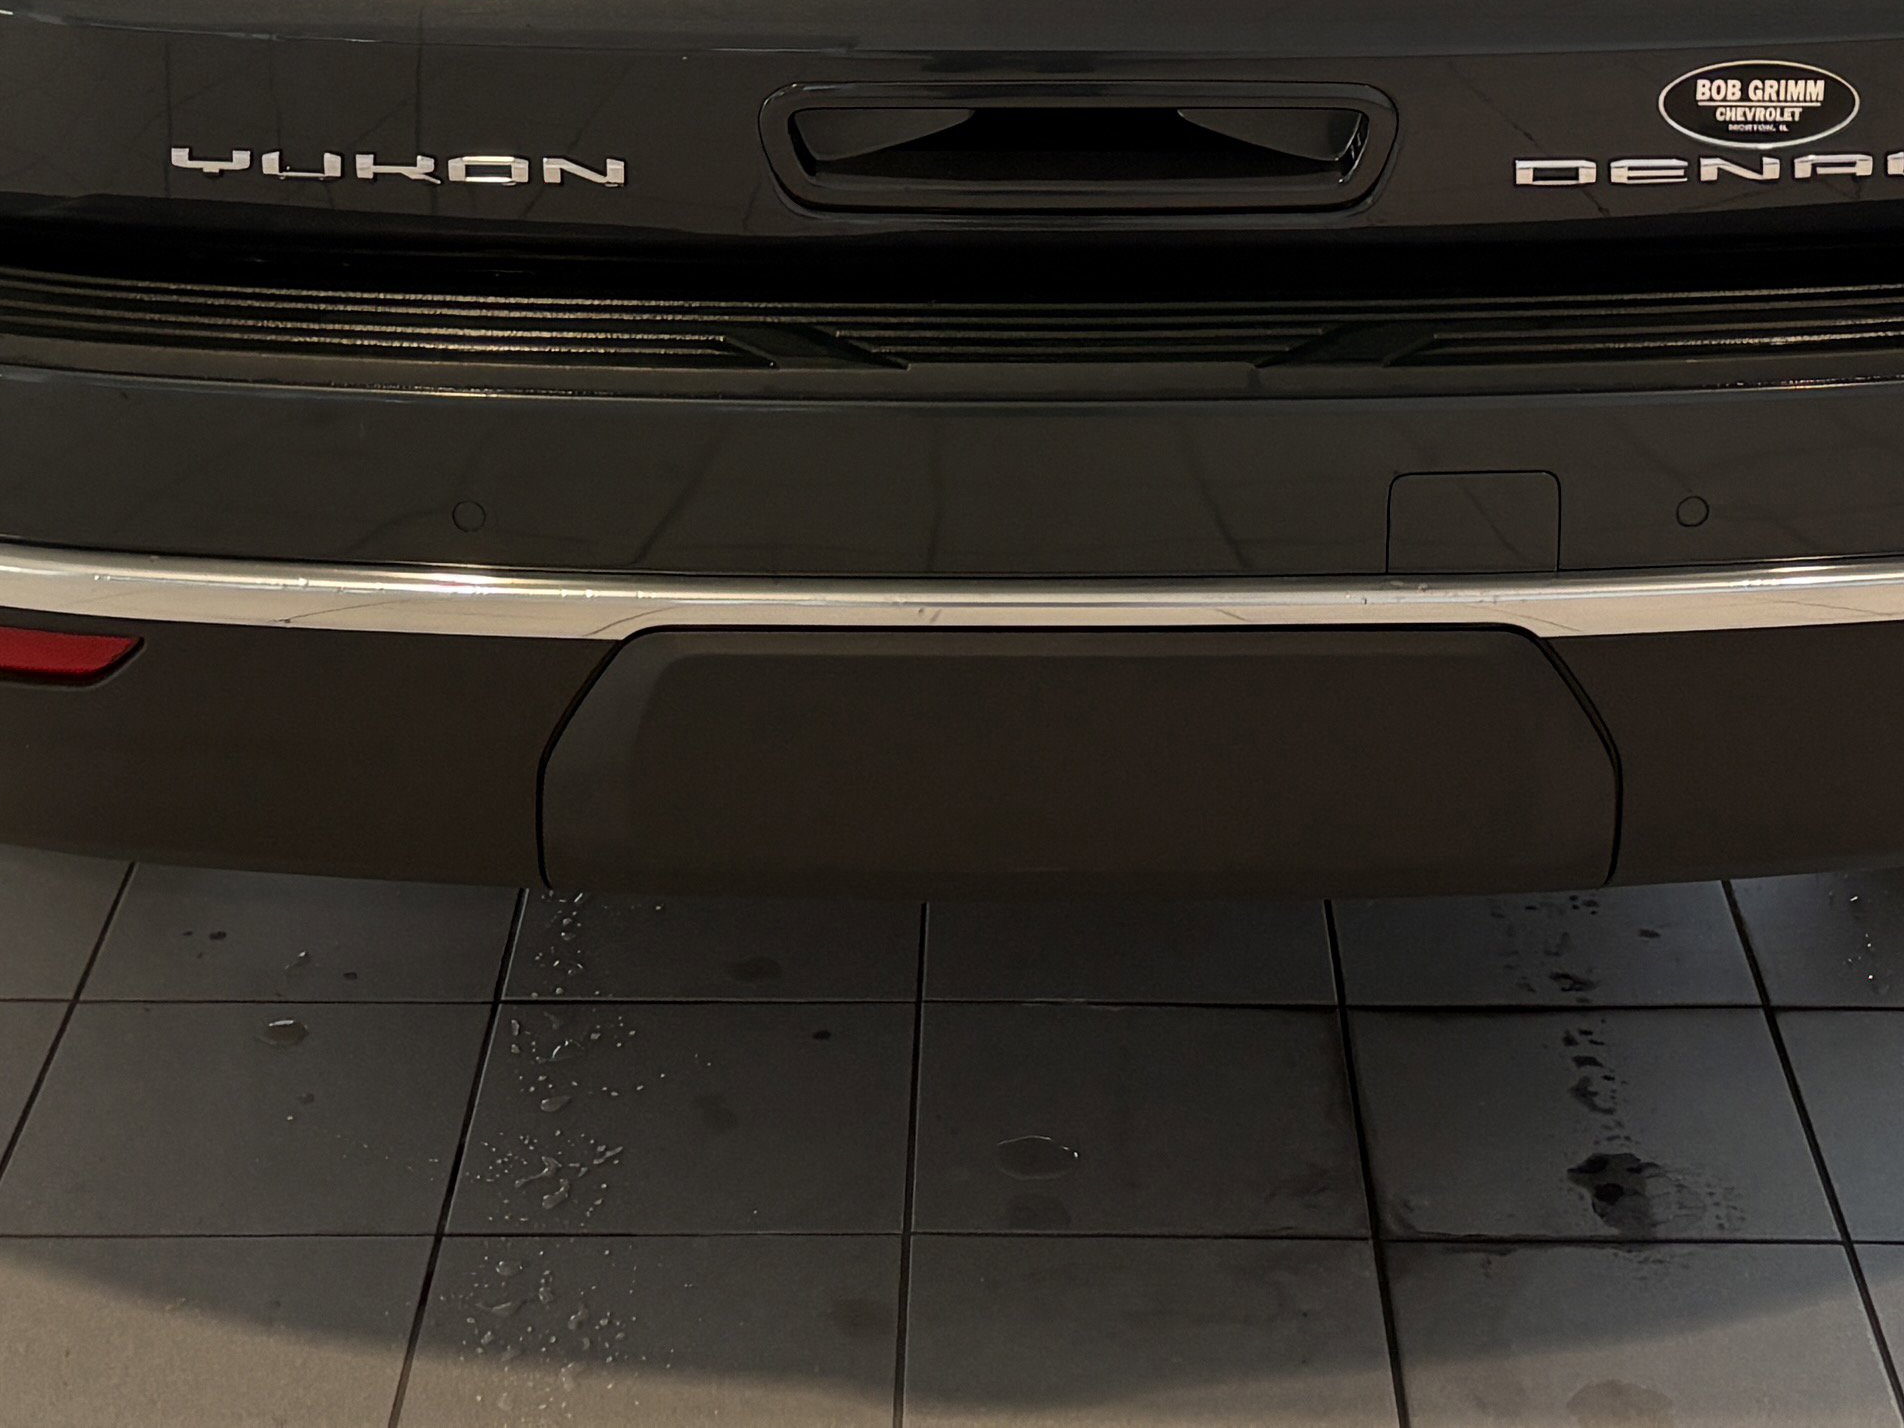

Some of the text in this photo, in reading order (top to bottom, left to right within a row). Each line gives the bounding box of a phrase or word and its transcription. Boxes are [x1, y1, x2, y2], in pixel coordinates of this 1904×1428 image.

[1696, 79, 1825, 102] BOB GRIMM
[1716, 107, 1803, 122] CHEVROLET
[171, 147, 626, 187] YUKON
